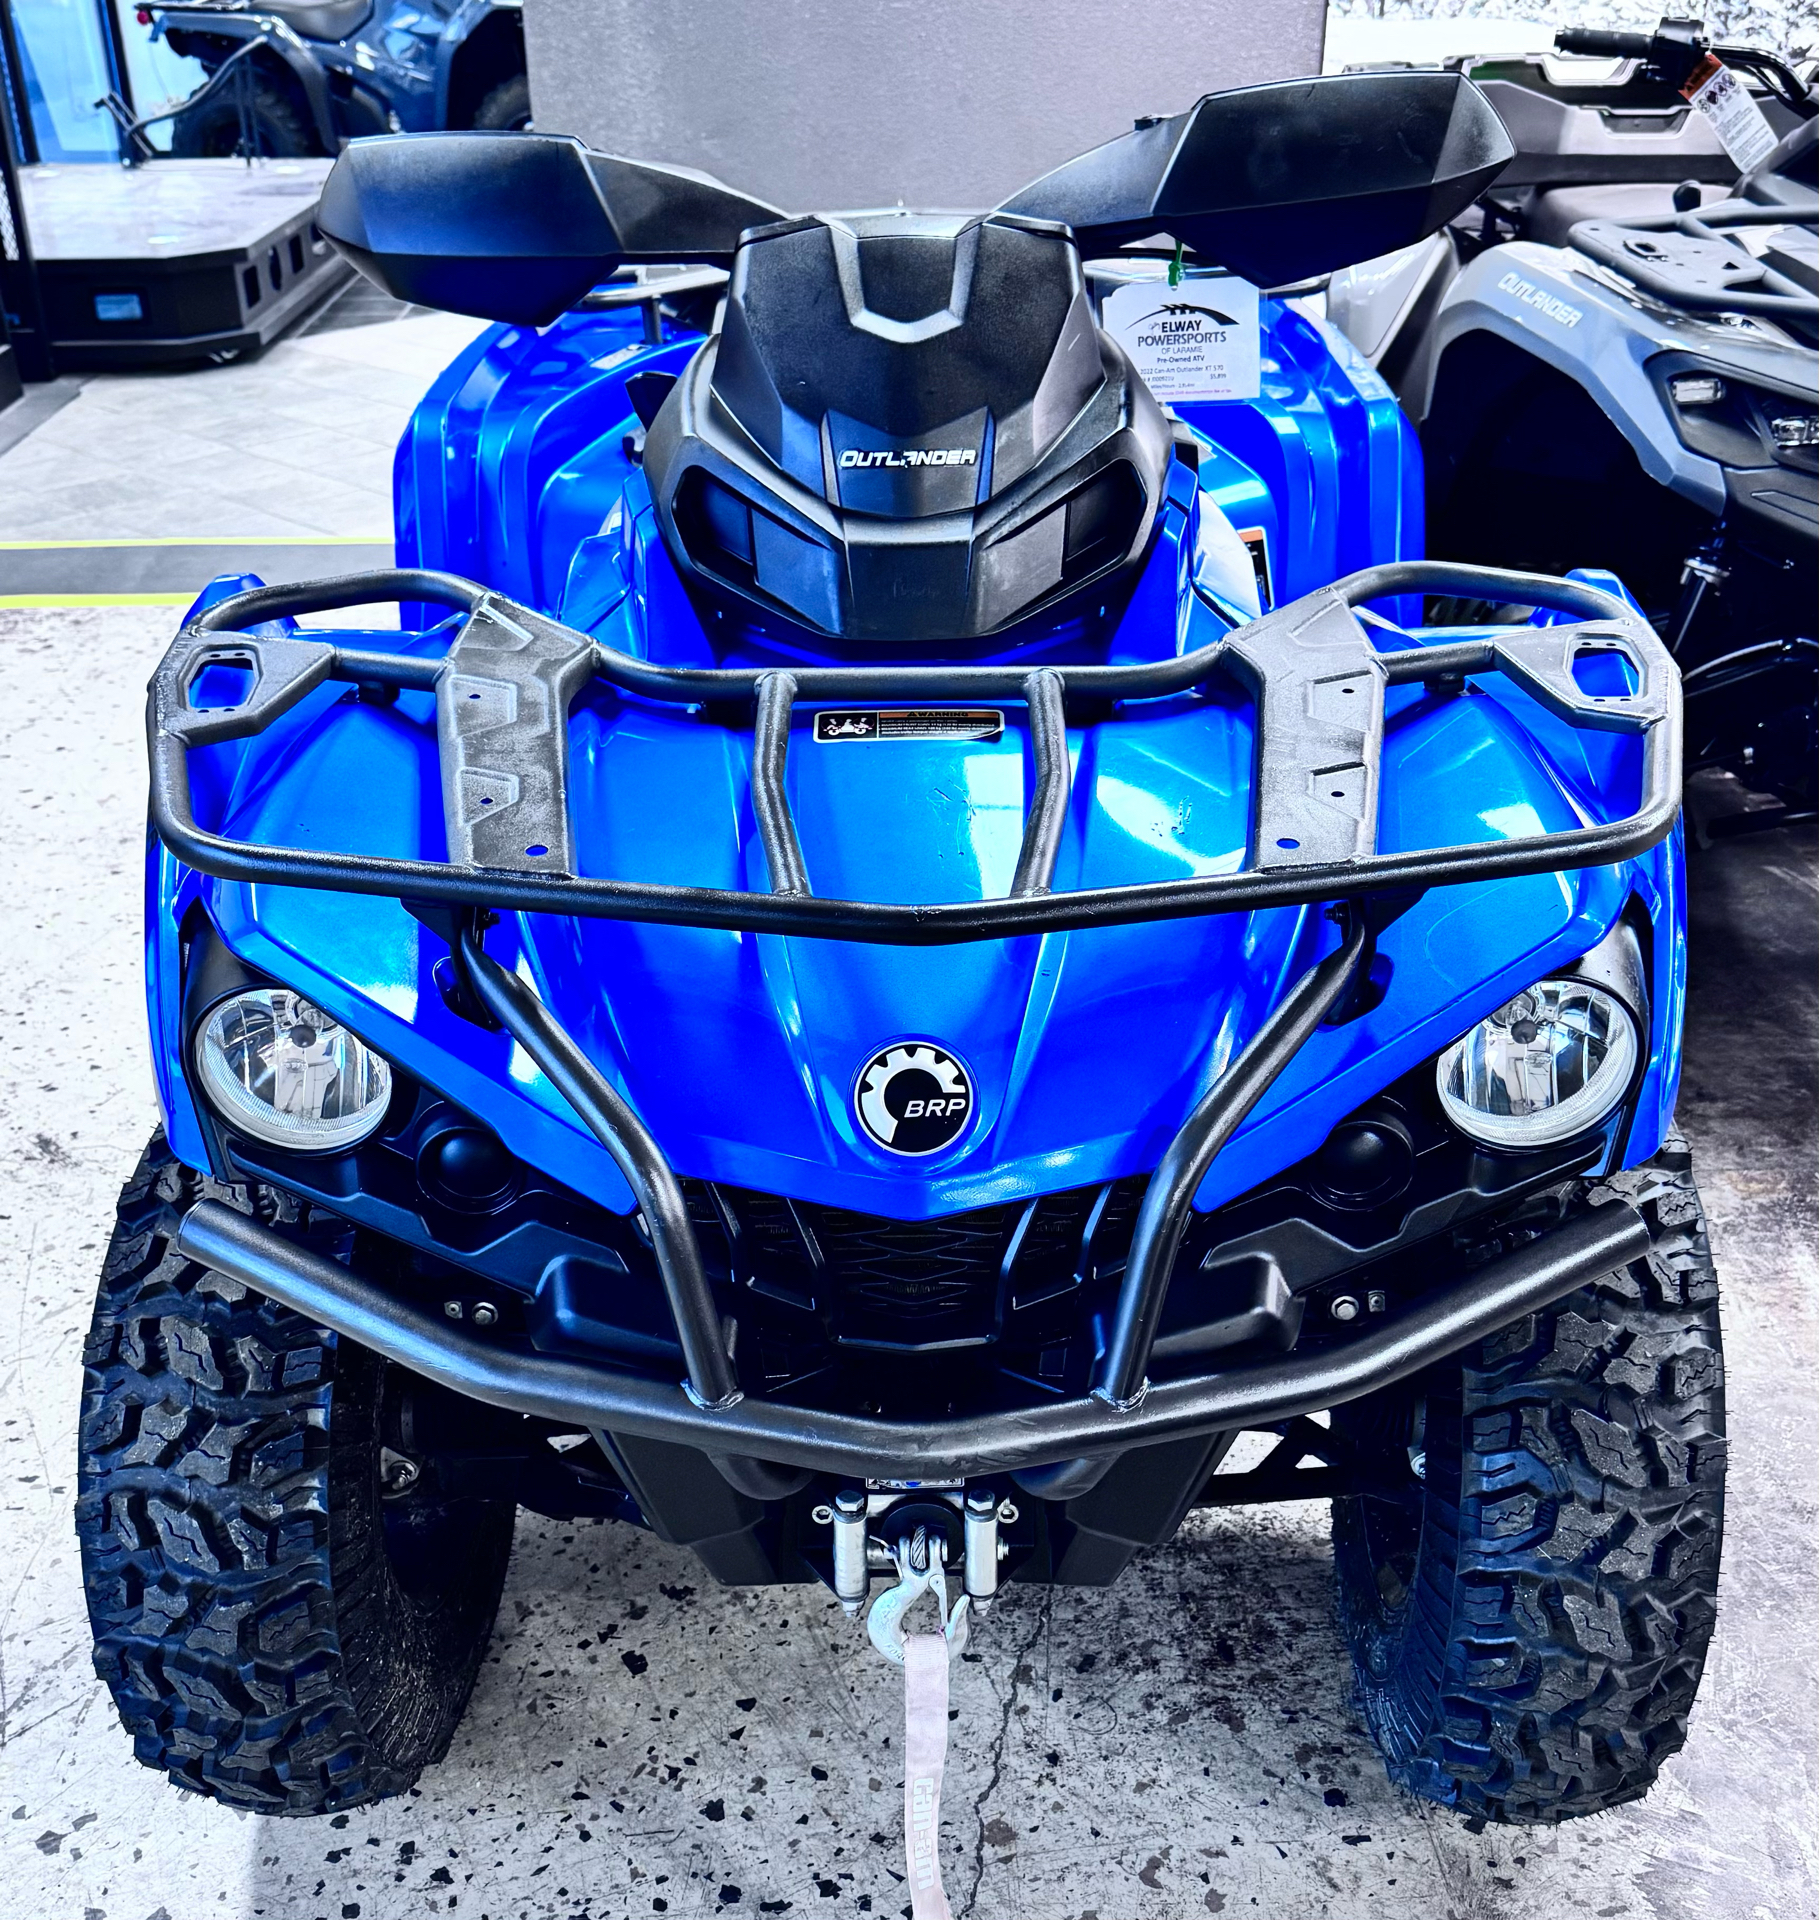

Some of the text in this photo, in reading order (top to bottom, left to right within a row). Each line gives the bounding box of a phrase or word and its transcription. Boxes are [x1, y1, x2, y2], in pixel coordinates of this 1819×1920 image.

[1497, 271, 1584, 328] OUTLANDER
[1161, 320, 1202, 333] ELWAY
[1138, 331, 1227, 347] POWERSPORTS
[1161, 346, 1203, 355] OF LARAMIE
[1157, 356, 1192, 364] Pre-Owned
[839, 449, 977, 467] OUTLANDER
[903, 1098, 966, 1118] BRP
